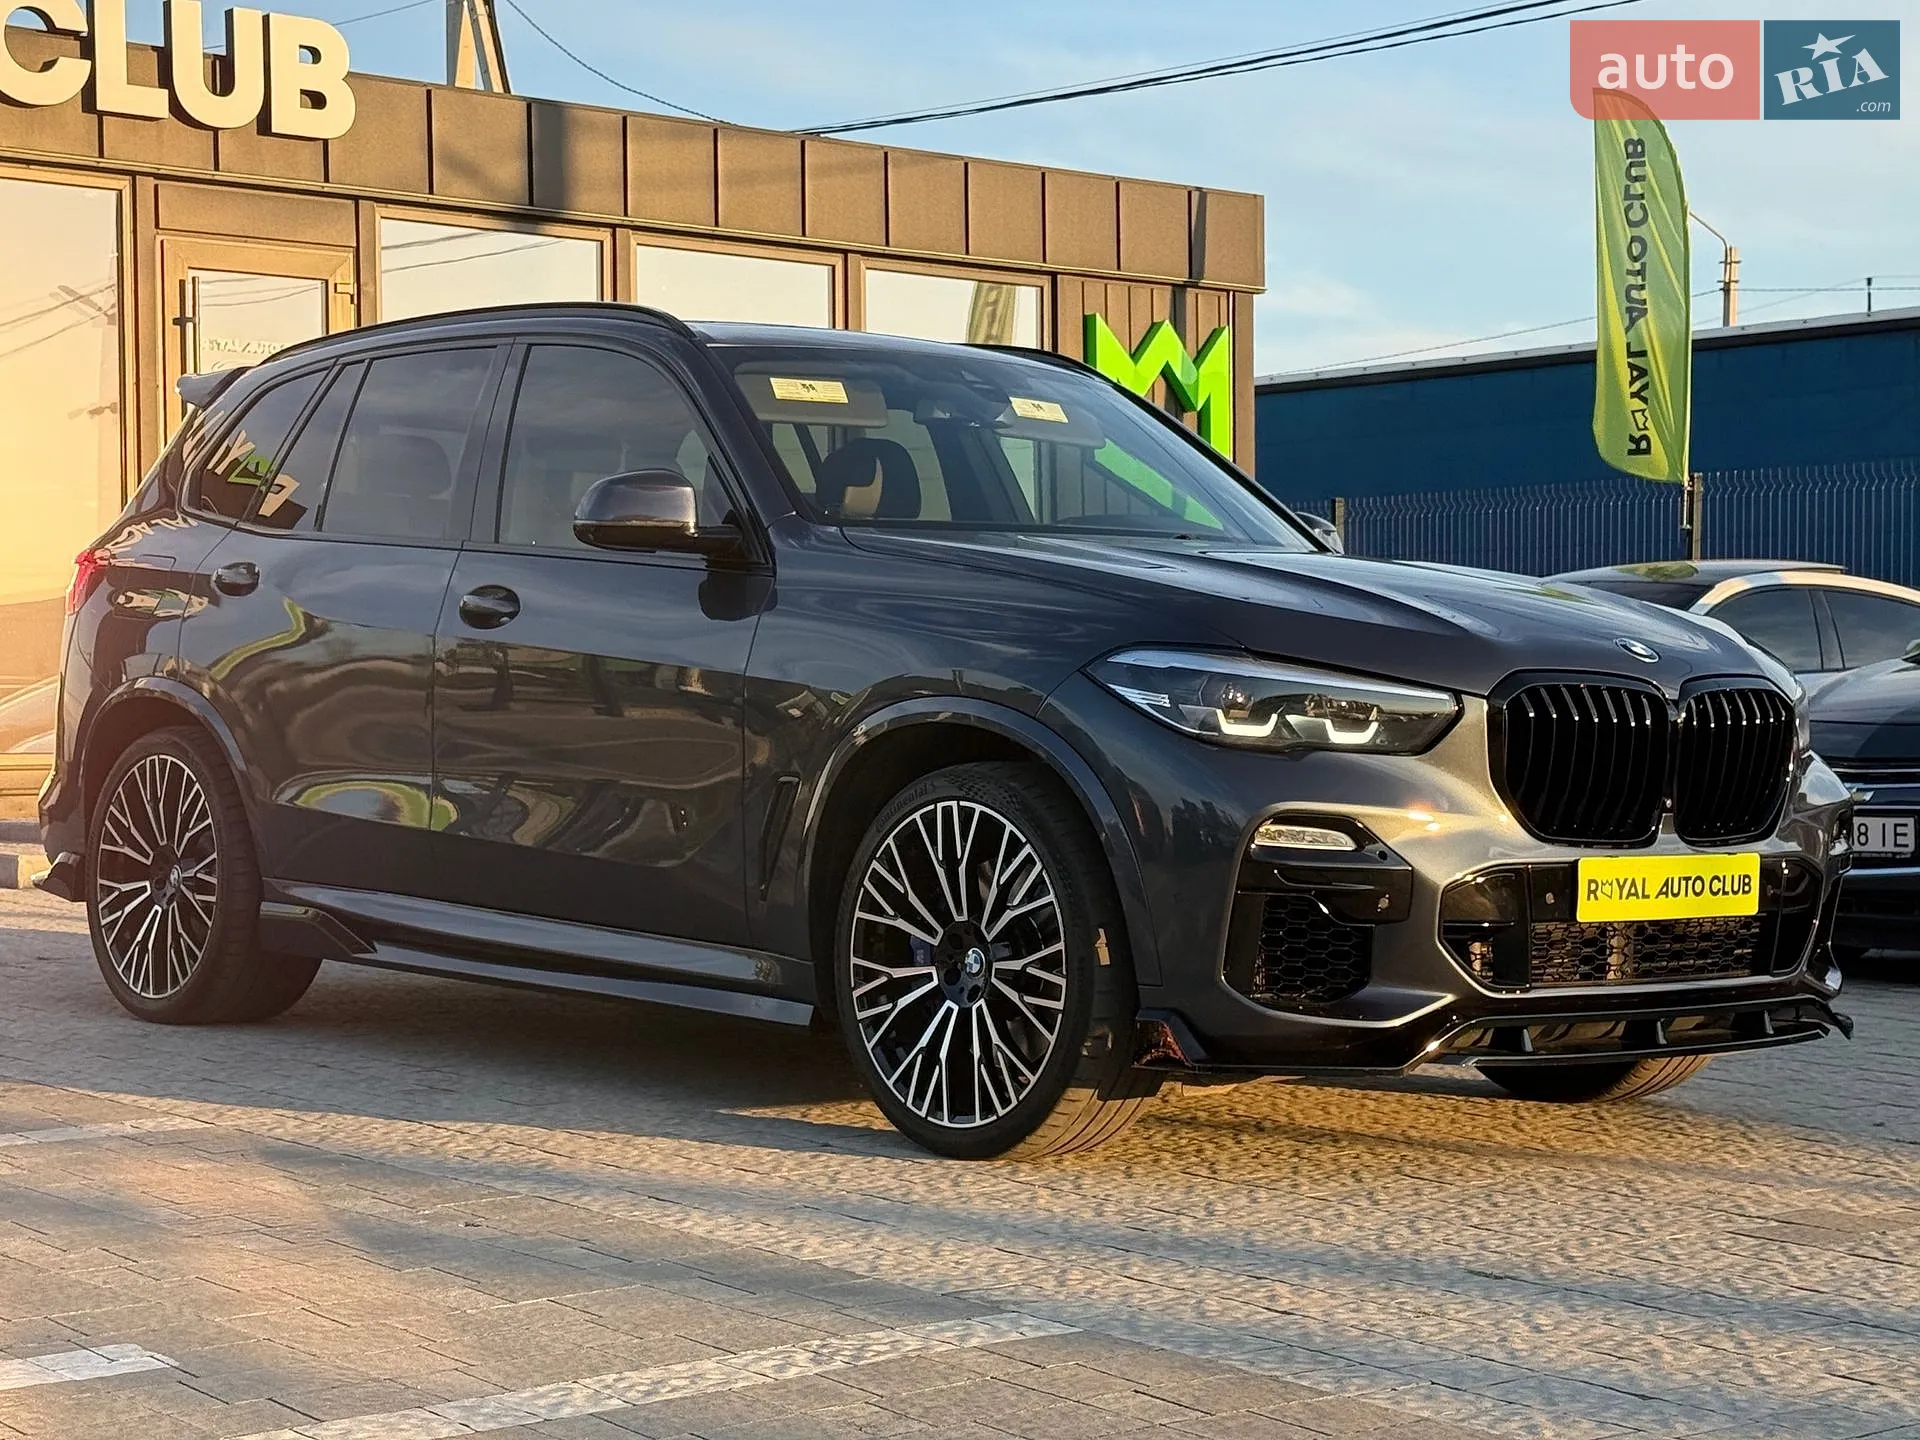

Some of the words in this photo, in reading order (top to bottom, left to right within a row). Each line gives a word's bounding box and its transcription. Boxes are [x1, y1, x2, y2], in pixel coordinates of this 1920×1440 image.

[0, 0, 356, 140] CLUB
[1851, 822, 1869, 847] 8
[1654, 874, 1705, 900] AUTO
[1709, 873, 1752, 897] CLUB
